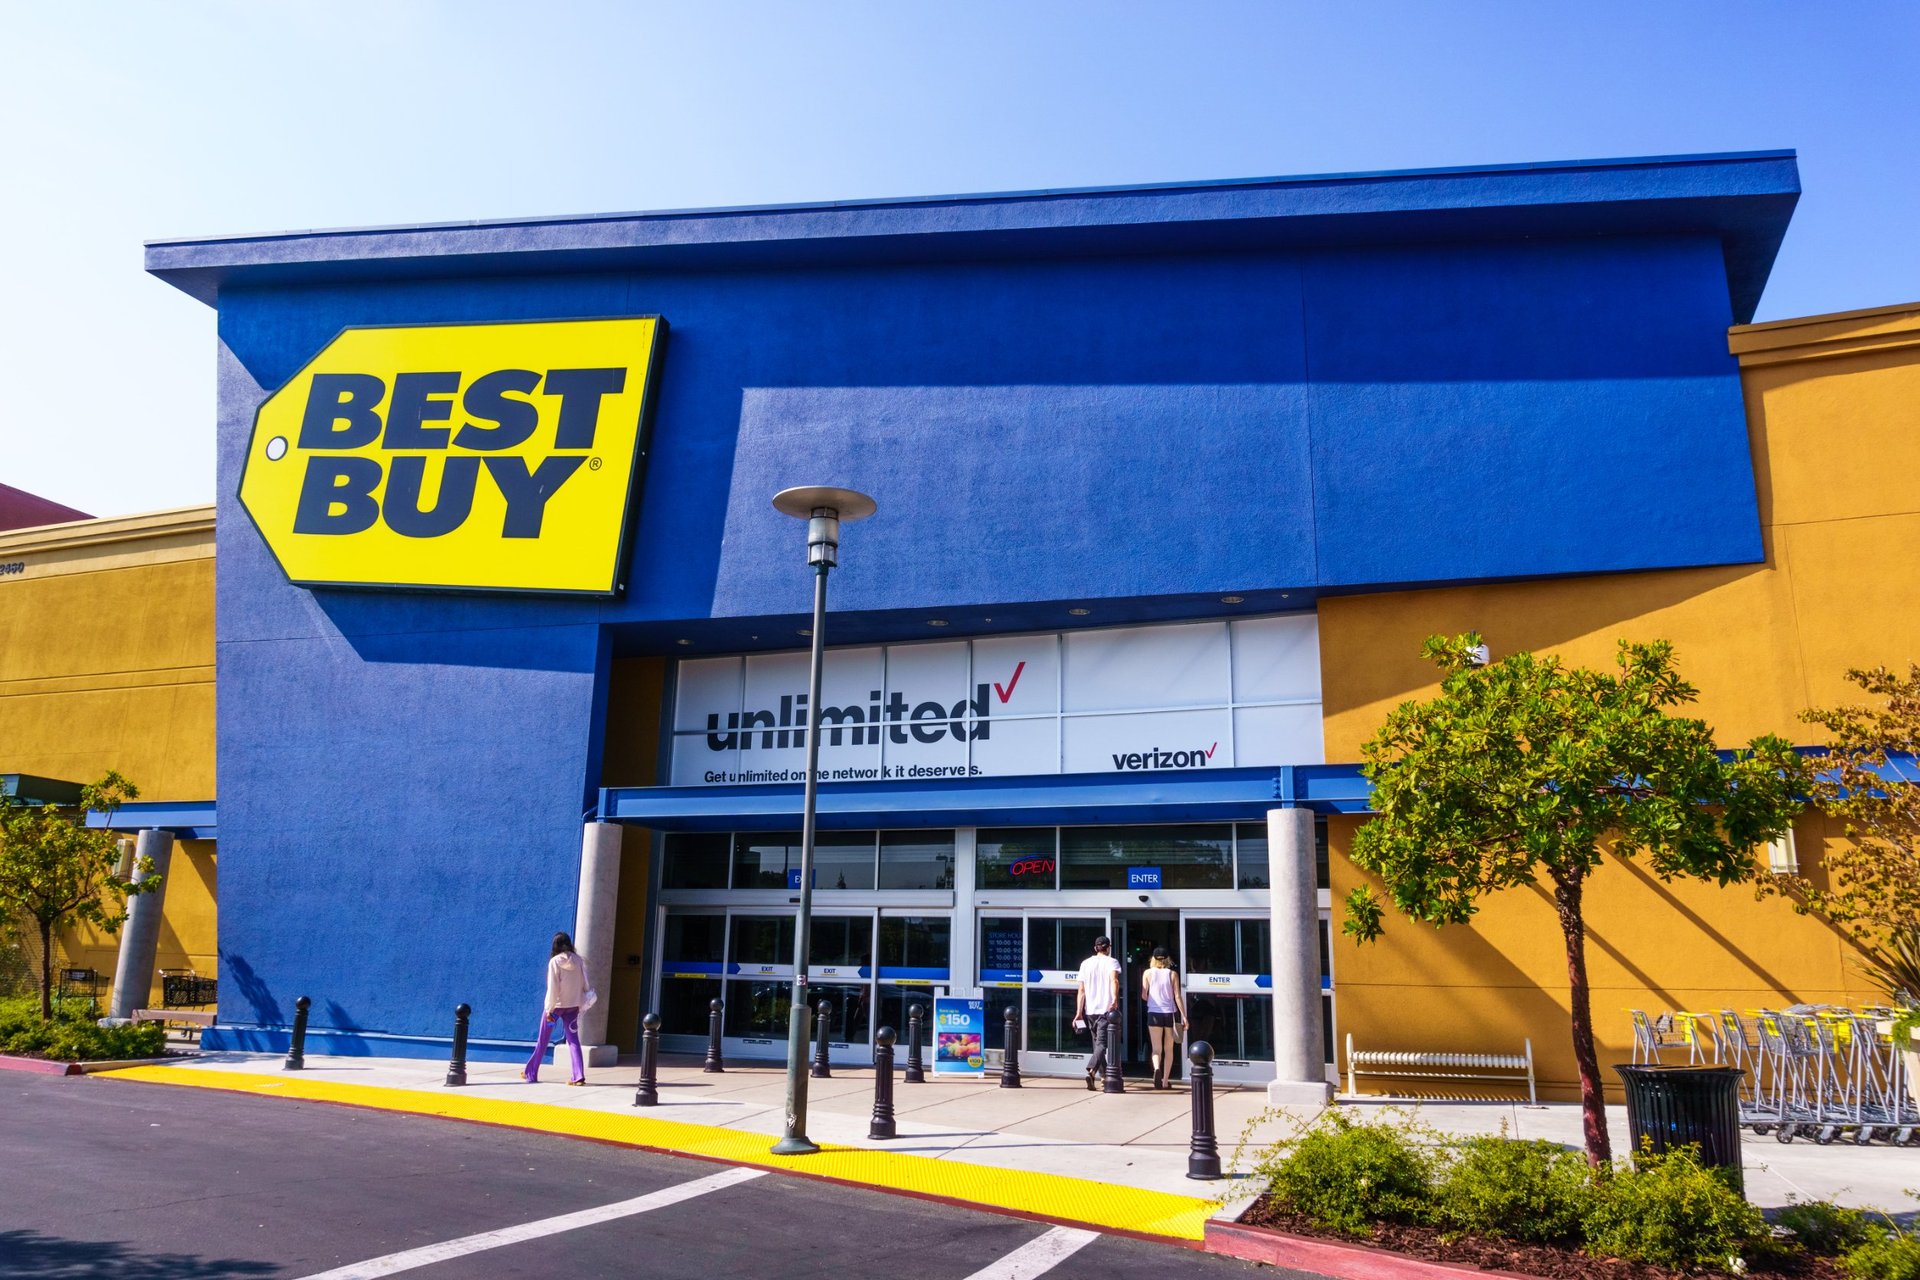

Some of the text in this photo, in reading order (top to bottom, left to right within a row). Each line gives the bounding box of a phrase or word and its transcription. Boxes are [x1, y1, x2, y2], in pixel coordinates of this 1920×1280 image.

[297, 367, 627, 451] BEST
[292, 455, 590, 538] BUY
[707, 684, 990, 751] unlimited
[1112, 747, 1206, 770] verizon
[704, 770, 727, 783] Get
[729, 768, 788, 783] unlimited
[790, 770, 806, 781] on
[832, 765, 892, 780] network
[895, 764, 905, 778] it
[907, 763, 983, 778] deserves.
[1012, 860, 1055, 875] OPEN
[1131, 874, 1158, 883] ENTER
[939, 1014, 970, 1025] $150
